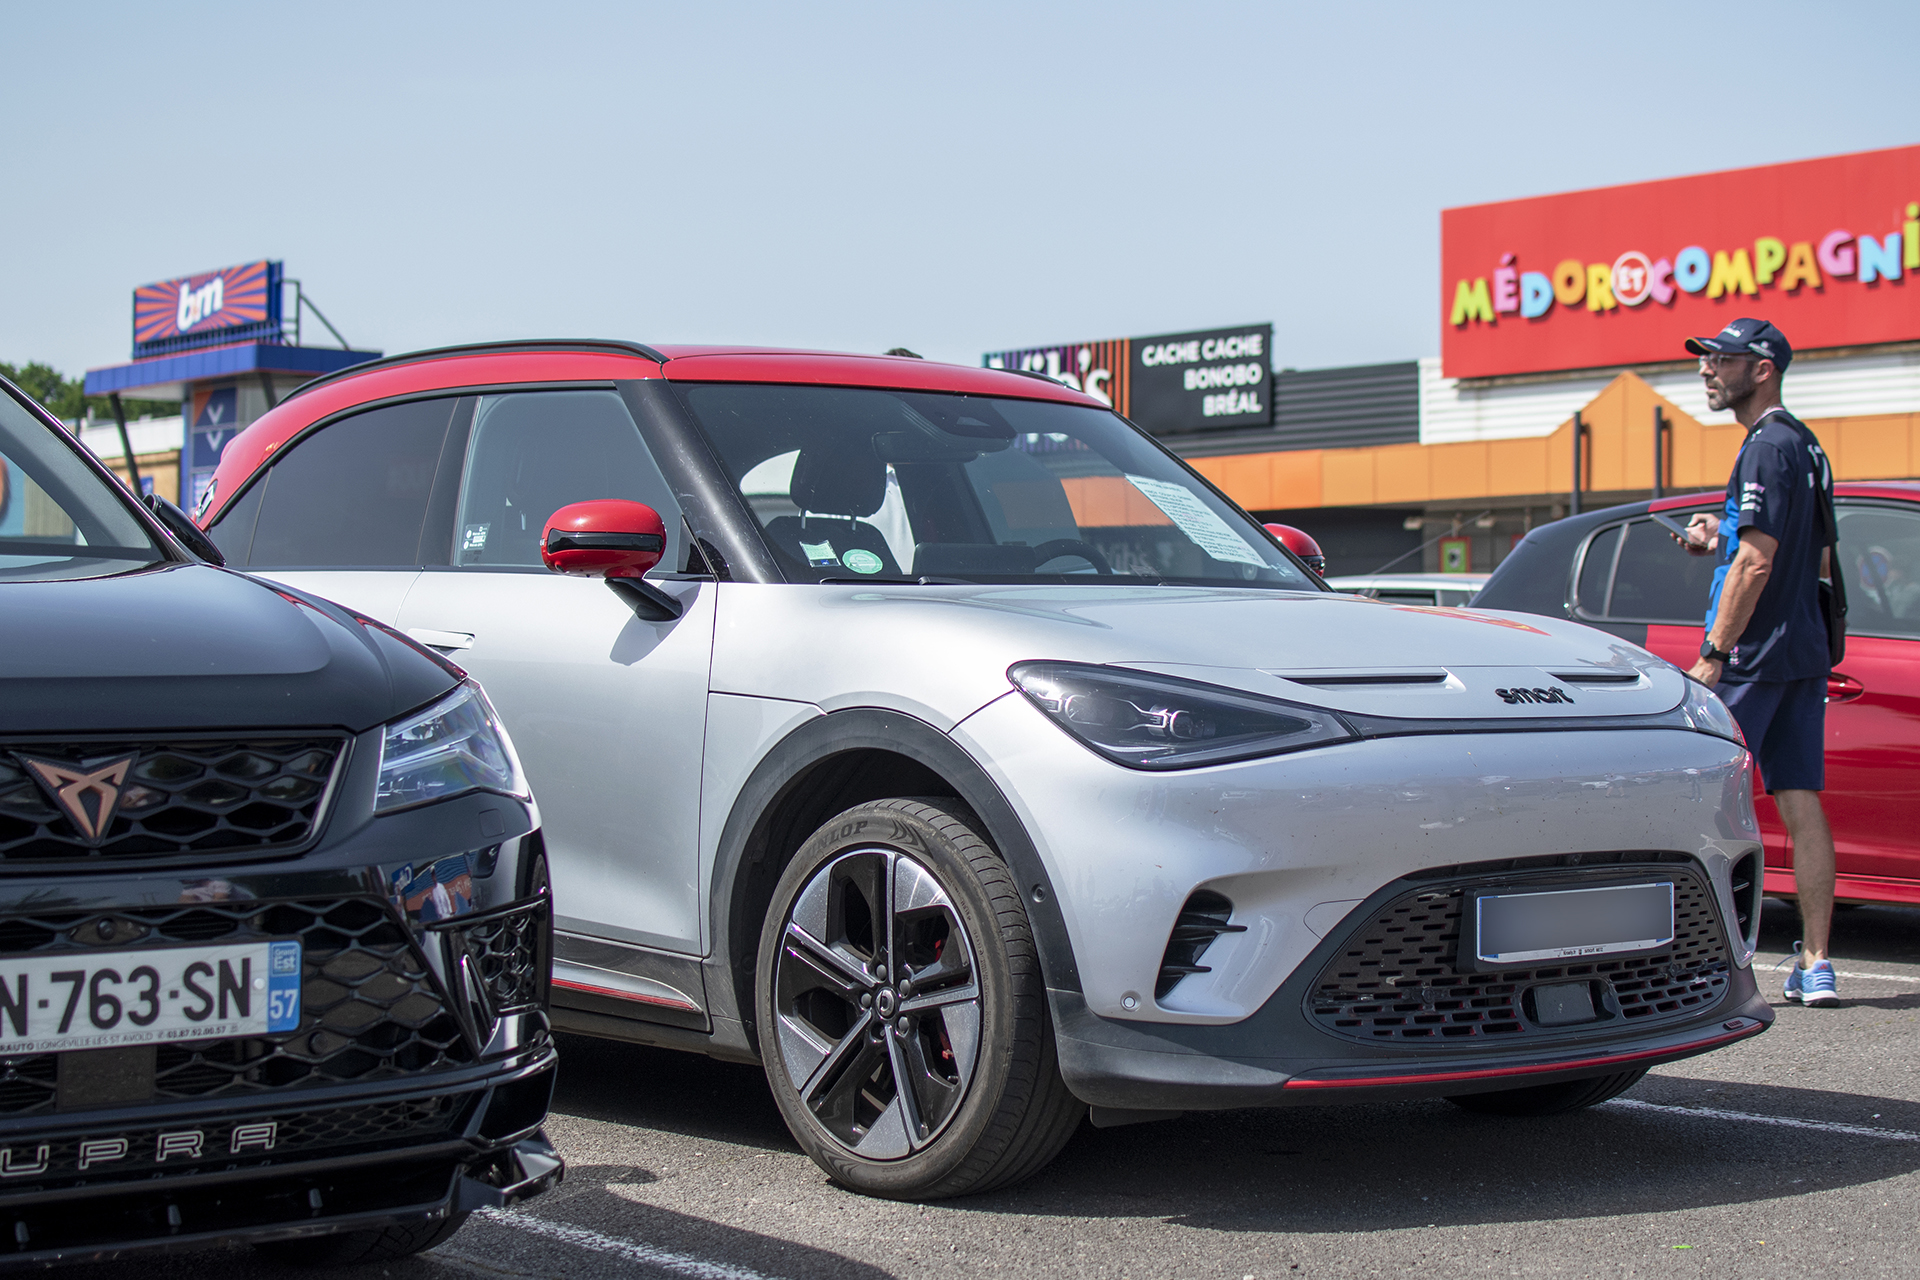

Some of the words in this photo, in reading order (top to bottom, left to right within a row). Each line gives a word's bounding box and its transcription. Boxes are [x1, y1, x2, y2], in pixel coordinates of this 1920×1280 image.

[1450, 252, 1617, 325] MÉDOR
[1617, 266, 1645, 292] ET
[1142, 344, 1200, 367] CACHE
[1202, 334, 1263, 360] CACHE
[1184, 362, 1263, 391] BONOBO
[1203, 388, 1263, 417] BRÉAL
[1494, 686, 1575, 704] smart
[273, 956, 296, 970] Est
[270, 988, 298, 1020] 57
